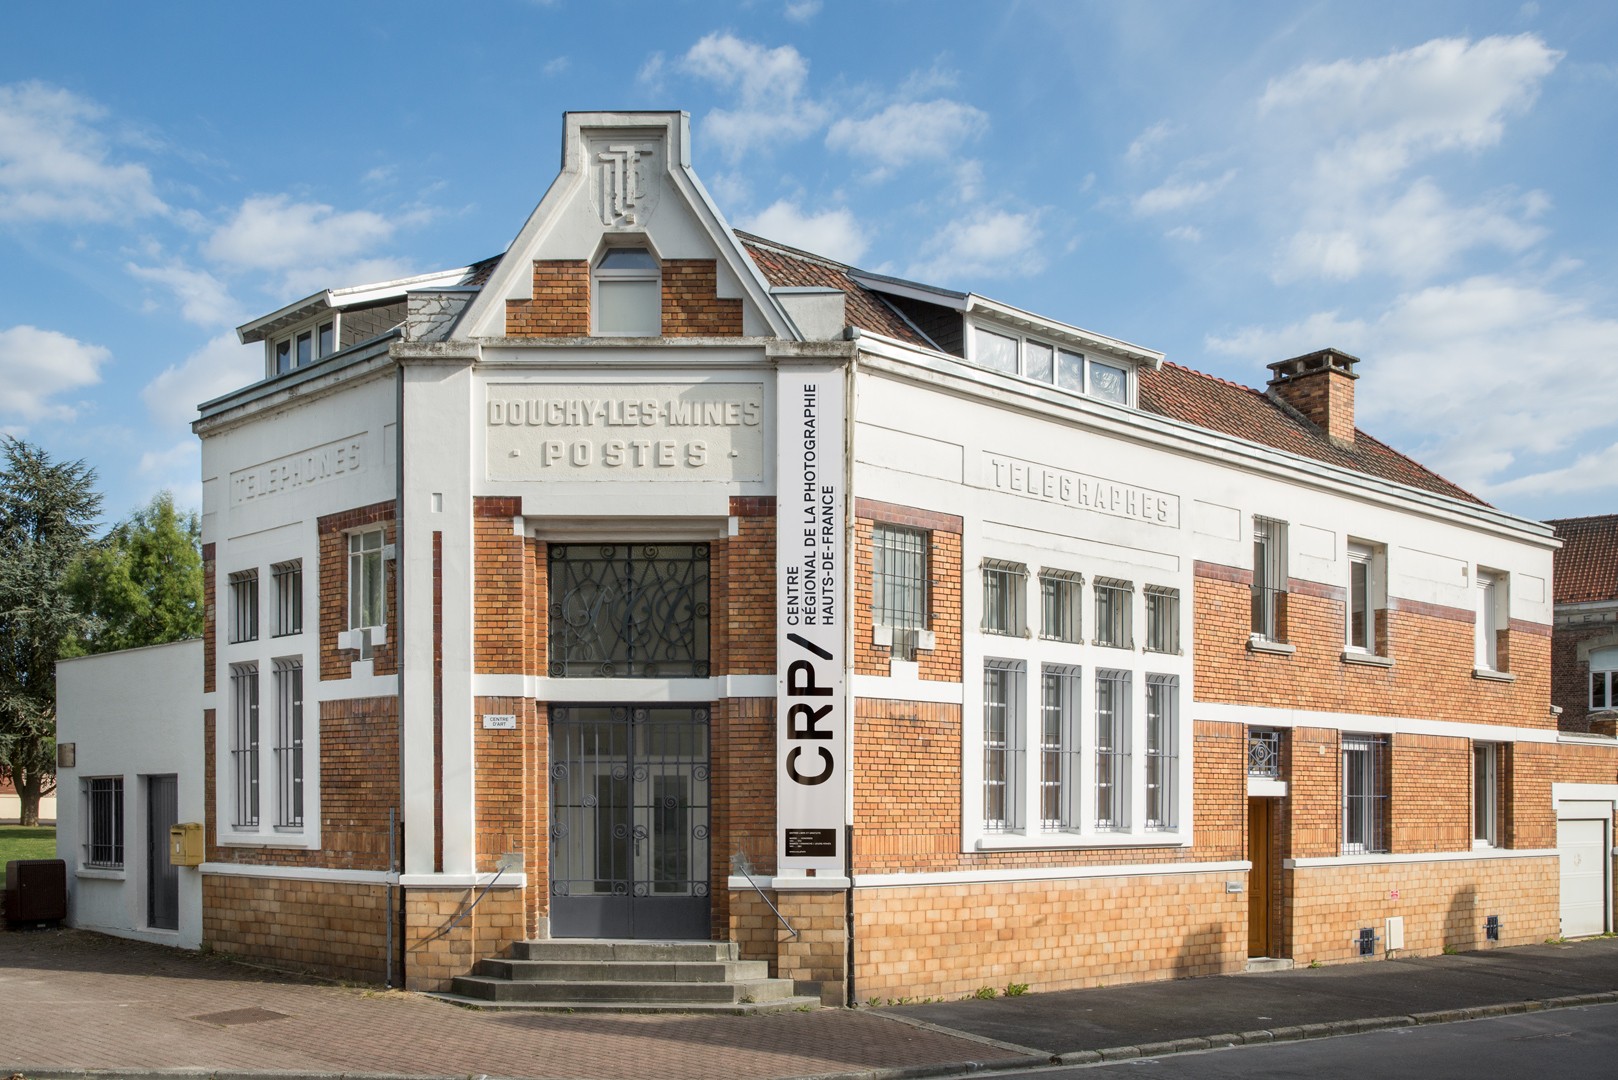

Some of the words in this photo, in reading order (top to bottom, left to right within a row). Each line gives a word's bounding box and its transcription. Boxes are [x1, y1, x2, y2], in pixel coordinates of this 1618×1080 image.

[235, 443, 360, 502] TELEPHONES
[541, 439, 708, 468] POSTES
[804, 384, 816, 502] PHOTOGRAPHIE
[804, 506, 816, 524] LA
[992, 459, 1168, 522] TELEGRAPHES
[804, 529, 816, 547] DE
[822, 486, 834, 625] HAUTS-DE-FRANCE
[786, 566, 799, 626] CENTRE
[801, 551, 816, 625] RÉGIONAL
